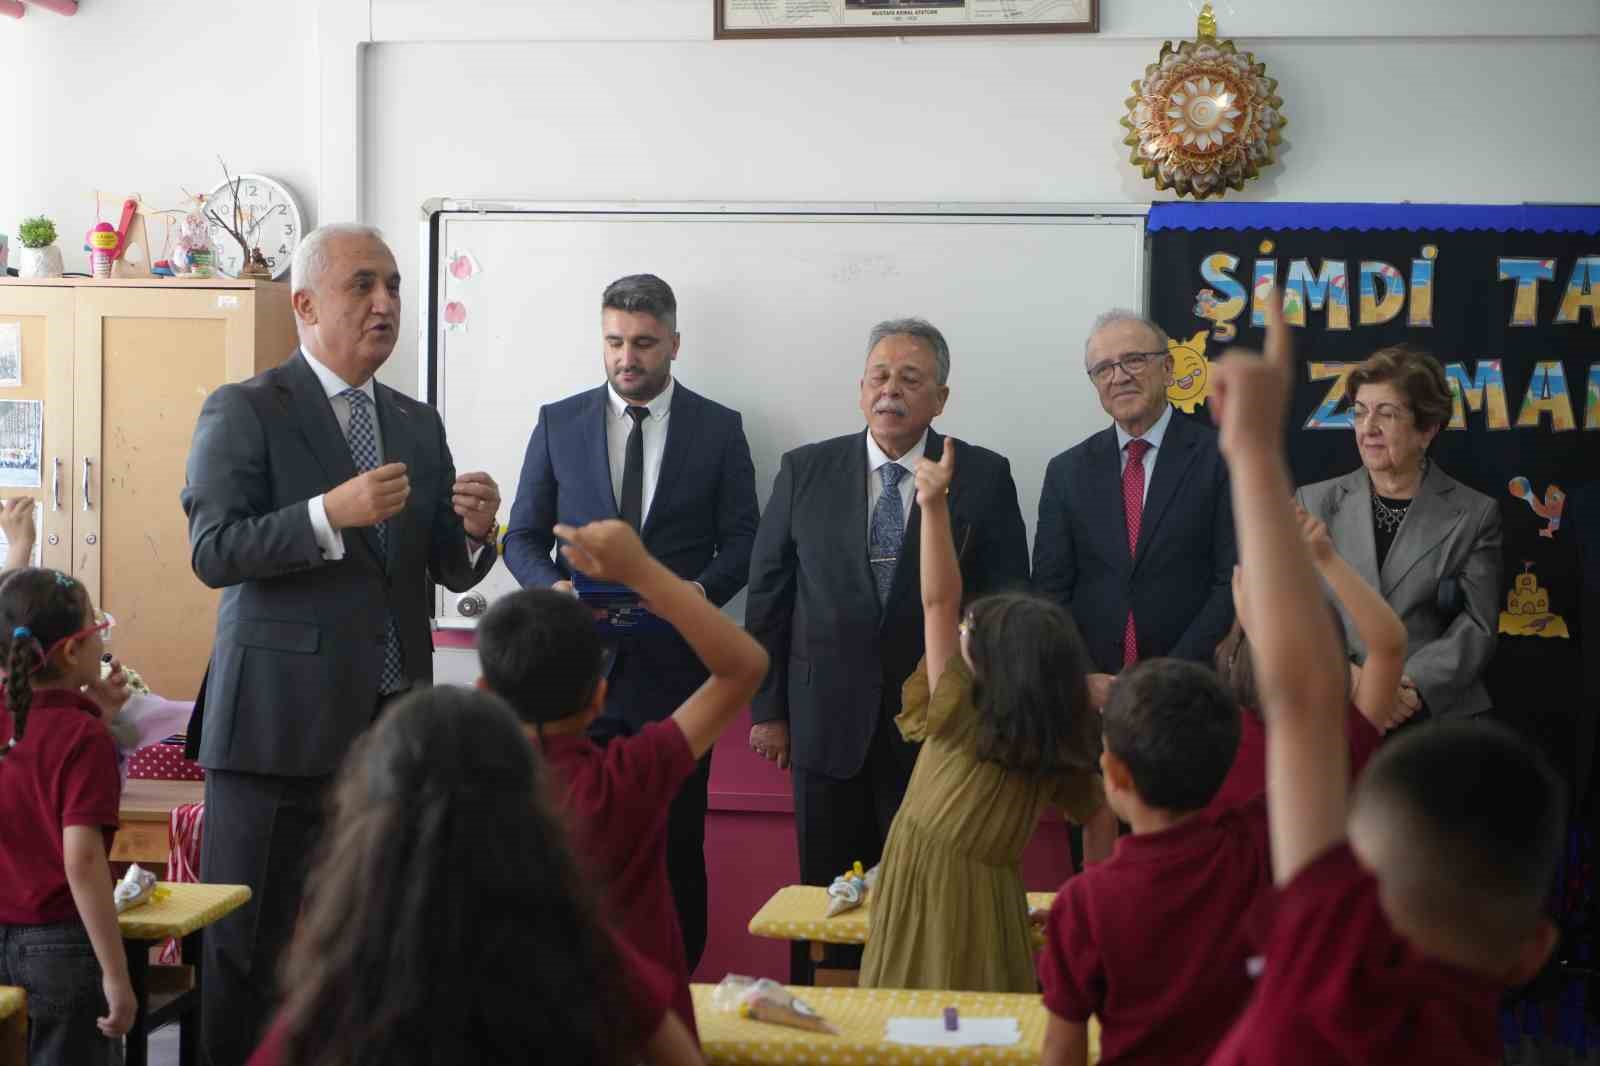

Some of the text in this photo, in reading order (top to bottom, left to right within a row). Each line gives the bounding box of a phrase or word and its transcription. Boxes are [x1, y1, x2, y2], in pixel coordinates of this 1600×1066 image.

[245, 185, 257, 197] 12
[278, 204, 287, 215] 2
[284, 224, 293, 235] 3
[279, 244, 287, 255] 4
[267, 256, 275, 267] 5
[1200, 239, 1439, 342] ŞİMDİ
[1302, 358, 1600, 432] ZMA
